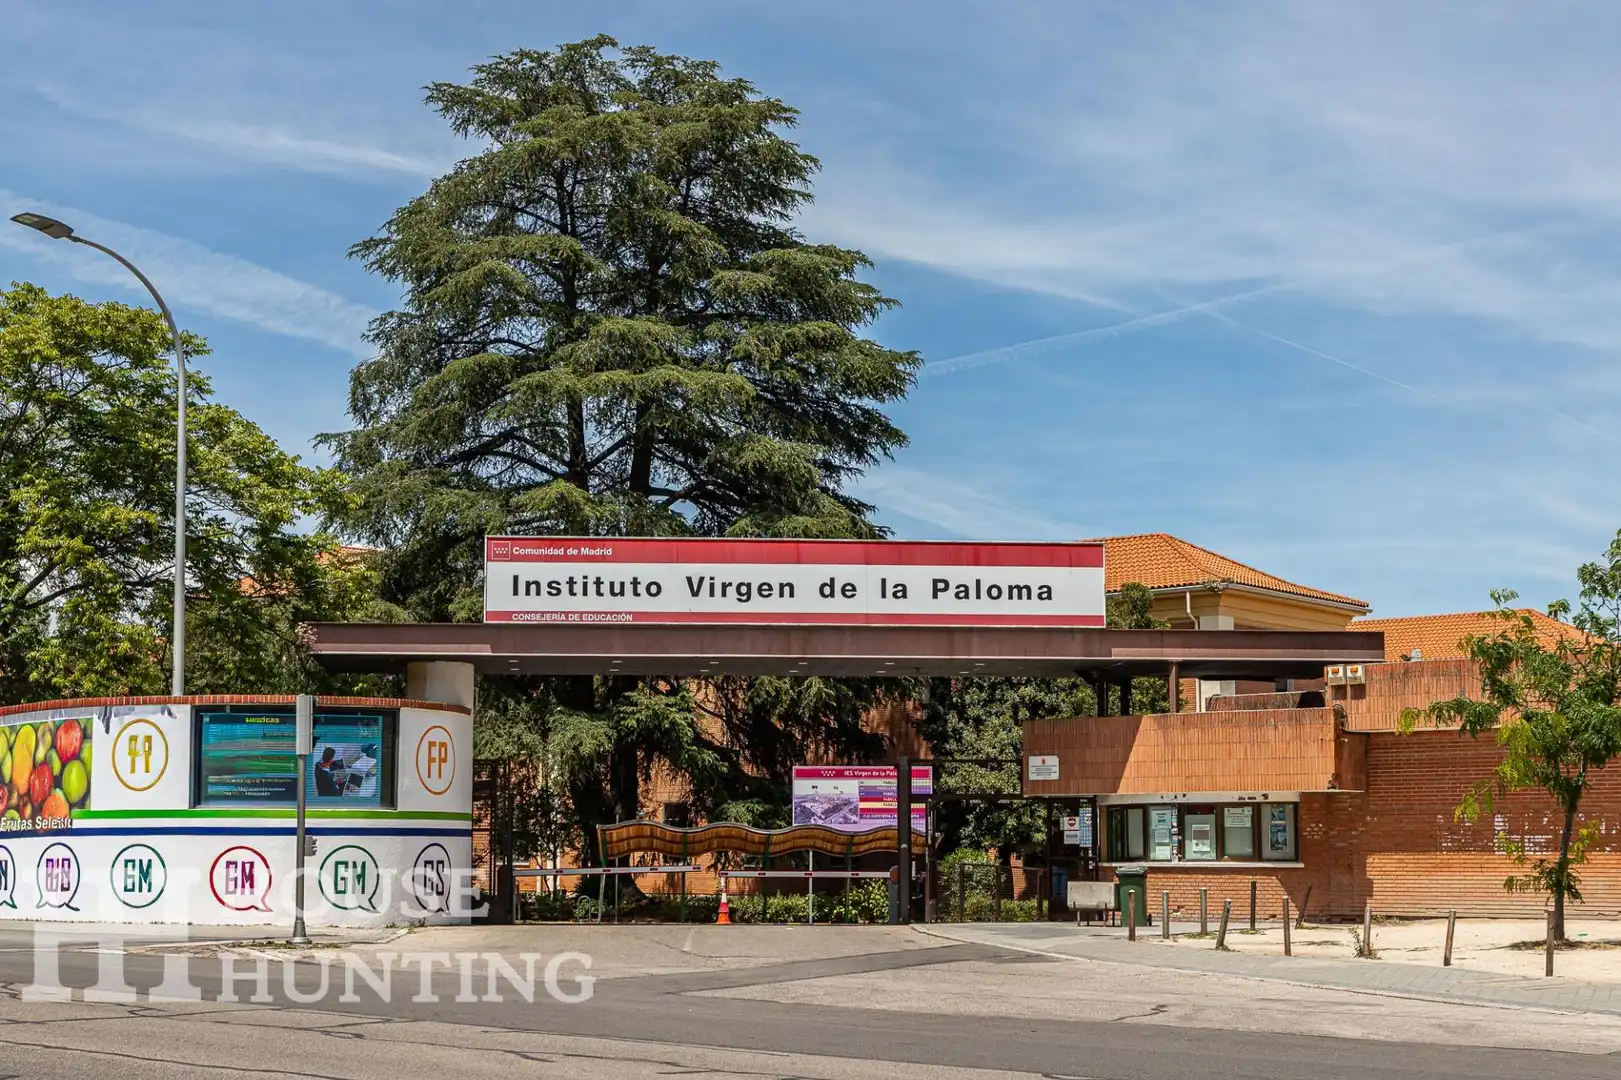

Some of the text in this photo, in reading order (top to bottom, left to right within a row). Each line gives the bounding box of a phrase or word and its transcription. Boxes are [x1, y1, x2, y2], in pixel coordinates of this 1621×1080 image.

[512, 546, 612, 556] Comunidad de Madrid
[512, 575, 1053, 603] Instituto Virgen de la Paloma
[512, 612, 633, 622] CONSEJERÍA DE EDUCACIÓN
[427, 740, 448, 779] FP
[855, 770, 872, 778] Virgen
[123, 858, 153, 893] GM
[225, 860, 255, 895] GM
[333, 860, 367, 895] GM
[424, 860, 445, 897] GS
